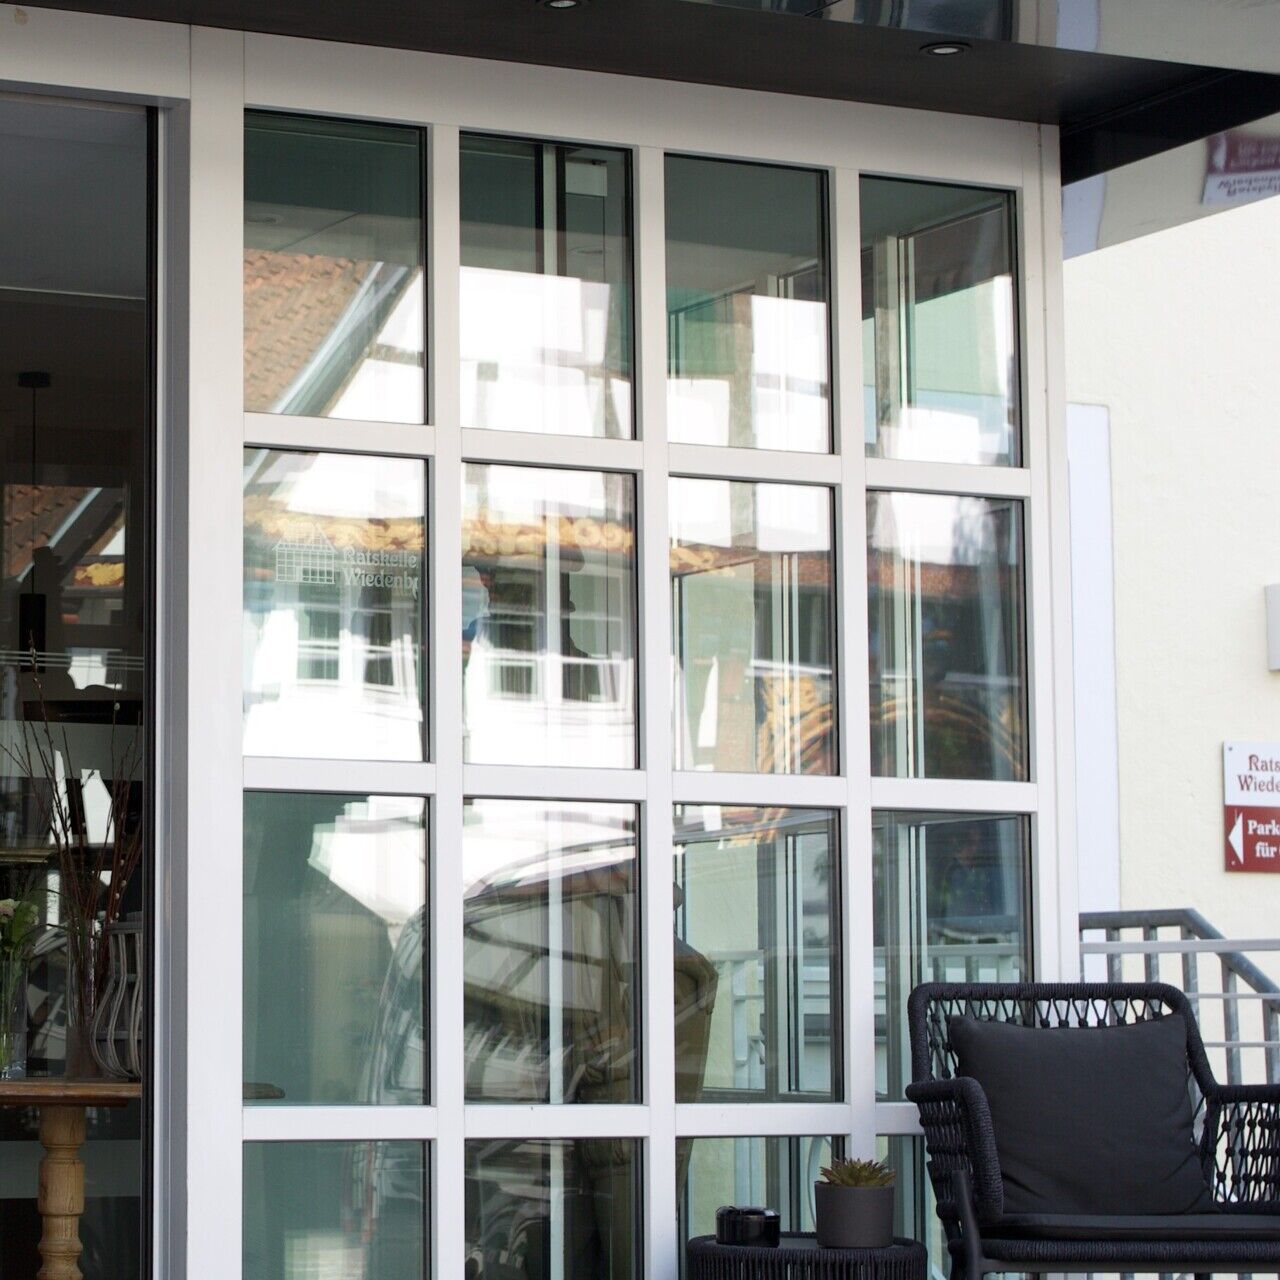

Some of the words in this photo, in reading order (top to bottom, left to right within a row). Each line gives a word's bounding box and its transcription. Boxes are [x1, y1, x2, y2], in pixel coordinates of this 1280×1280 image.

[343, 545, 419, 569] Ratskelle
[1248, 754, 1280, 773] Rats
[1247, 819, 1280, 836] Park
[1255, 840, 1277, 858] für
